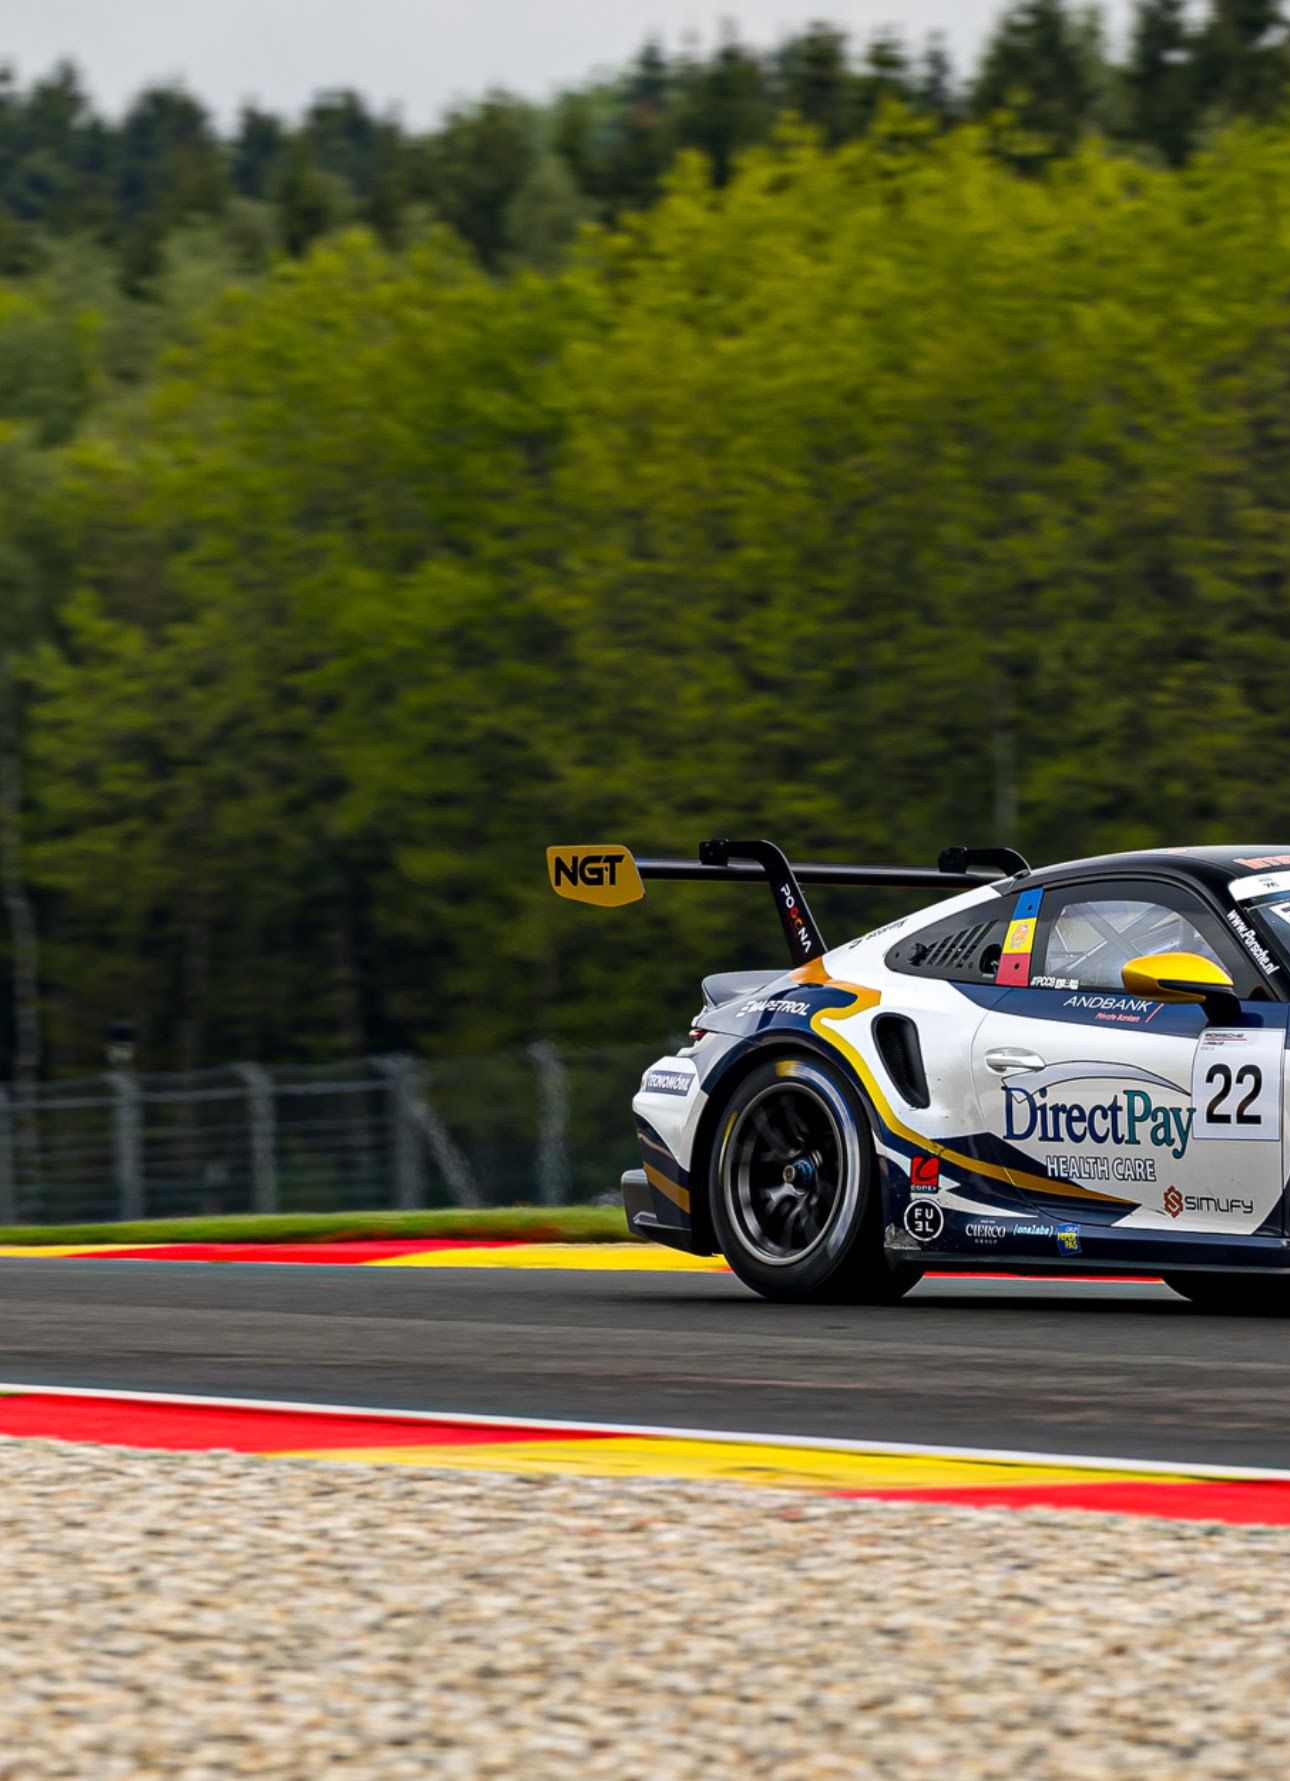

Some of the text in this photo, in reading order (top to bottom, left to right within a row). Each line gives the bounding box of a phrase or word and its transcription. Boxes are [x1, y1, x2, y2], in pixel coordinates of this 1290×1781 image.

[554, 854, 625, 887] NGT
[1063, 996, 1153, 1012] ANDBANK
[1205, 1063, 1263, 1125] 22
[1000, 1086, 1197, 1160] DirectPay
[1046, 1155, 1157, 1182] HEALTH CARE
[965, 1224, 1006, 1238] CIERCO
